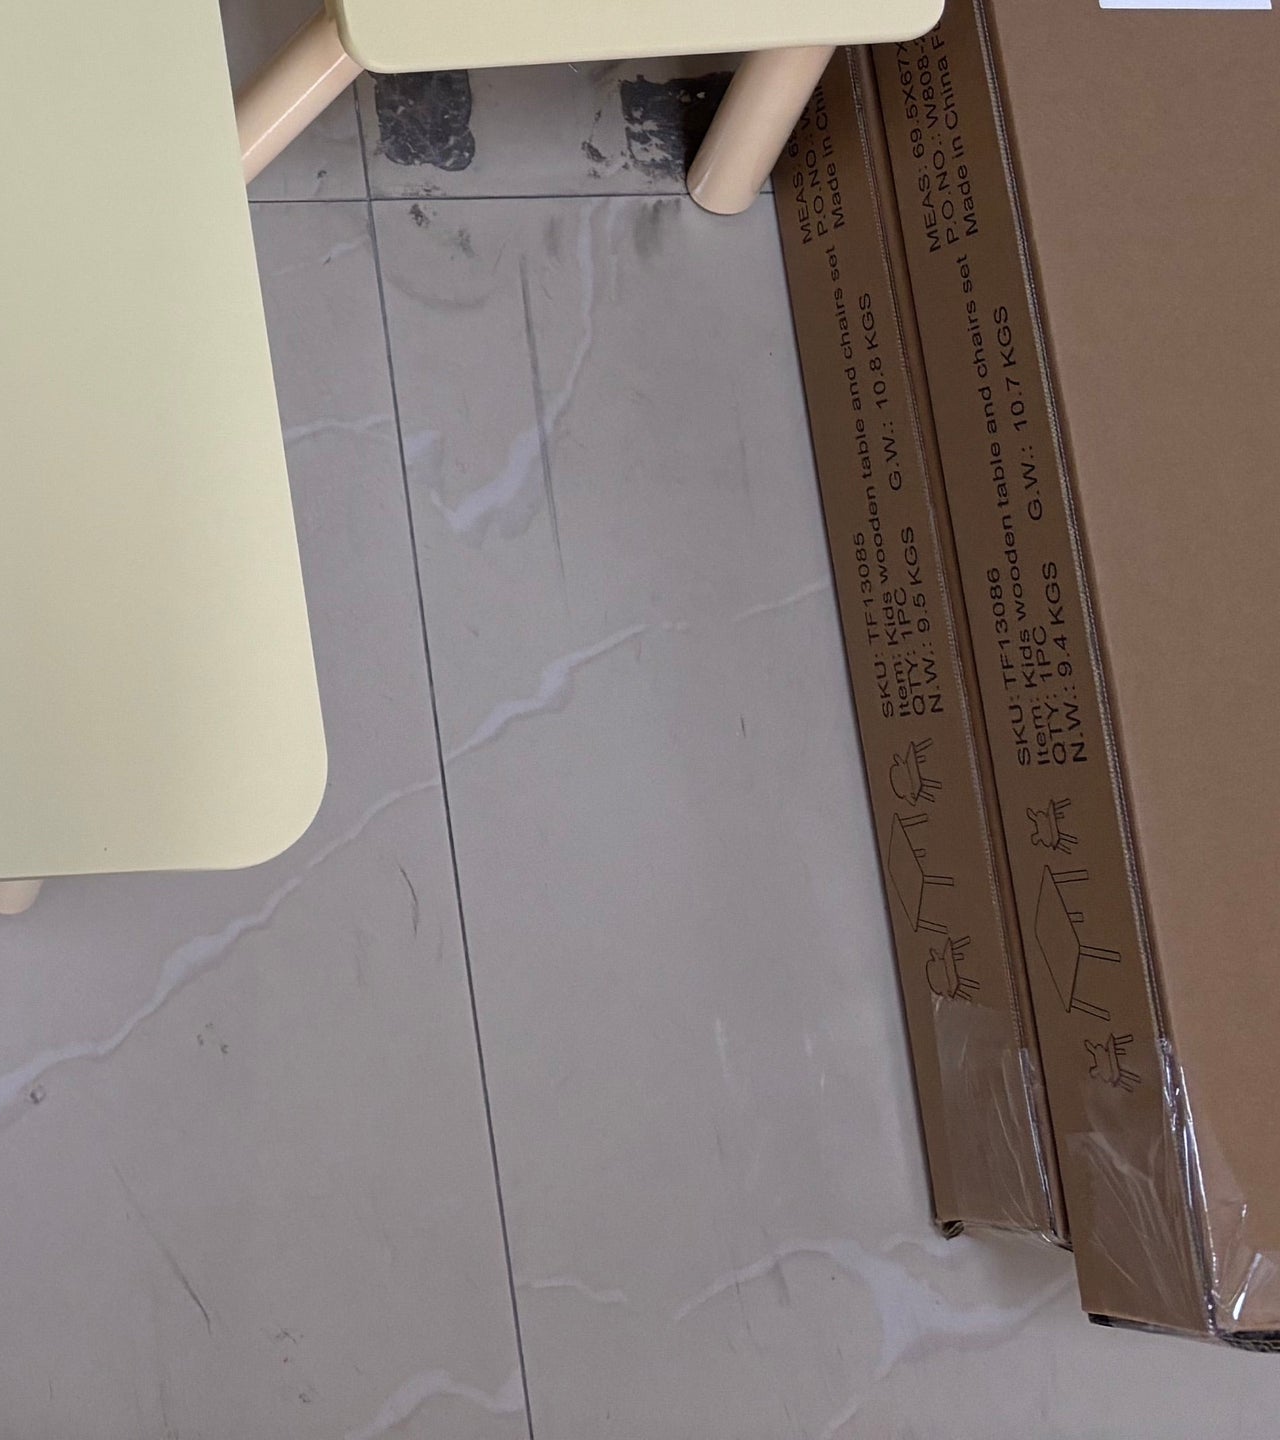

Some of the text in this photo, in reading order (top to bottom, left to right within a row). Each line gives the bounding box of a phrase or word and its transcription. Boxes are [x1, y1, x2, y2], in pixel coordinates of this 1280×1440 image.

[938, 55, 978, 236] Made in China
[956, 254, 1050, 764] Item: Kids wooden table and chairs set
[994, 306, 1042, 521] G.W.: 10.7 KGS
[853, 532, 893, 718] SKU: TF13085
[901, 526, 944, 713] N.W.: 9.5 KGS
[988, 568, 1031, 766] SKU: TF13086
[1033, 626, 1067, 764] QTY: 1PC
[1042, 562, 1087, 762] N.W.: 9.4 KGS
